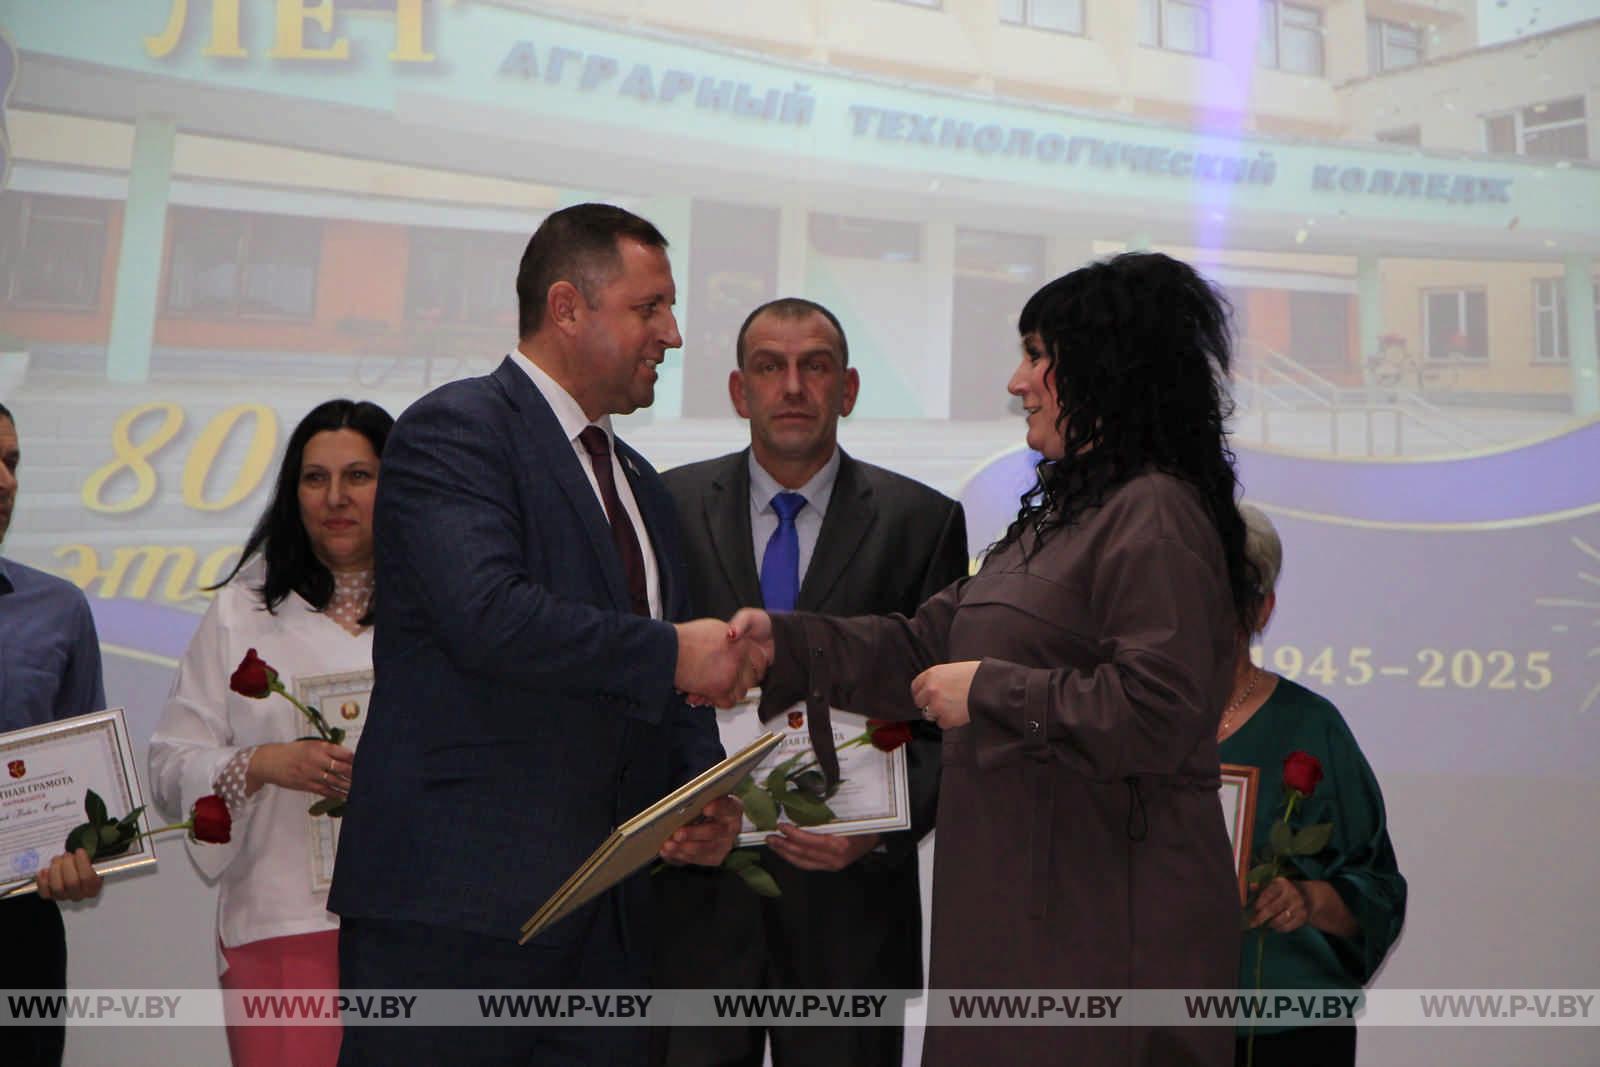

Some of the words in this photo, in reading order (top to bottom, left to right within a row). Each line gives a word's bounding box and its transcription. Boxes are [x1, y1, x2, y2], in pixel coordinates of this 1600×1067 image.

[499, 40, 816, 126] АГРАРНЫЙ
[848, 104, 1277, 187] ТЕХНОЛОГИЧЕСКИЙ
[1312, 164, 1513, 204] КОЛЛЕДЖ
[82, 403, 278, 513] 80
